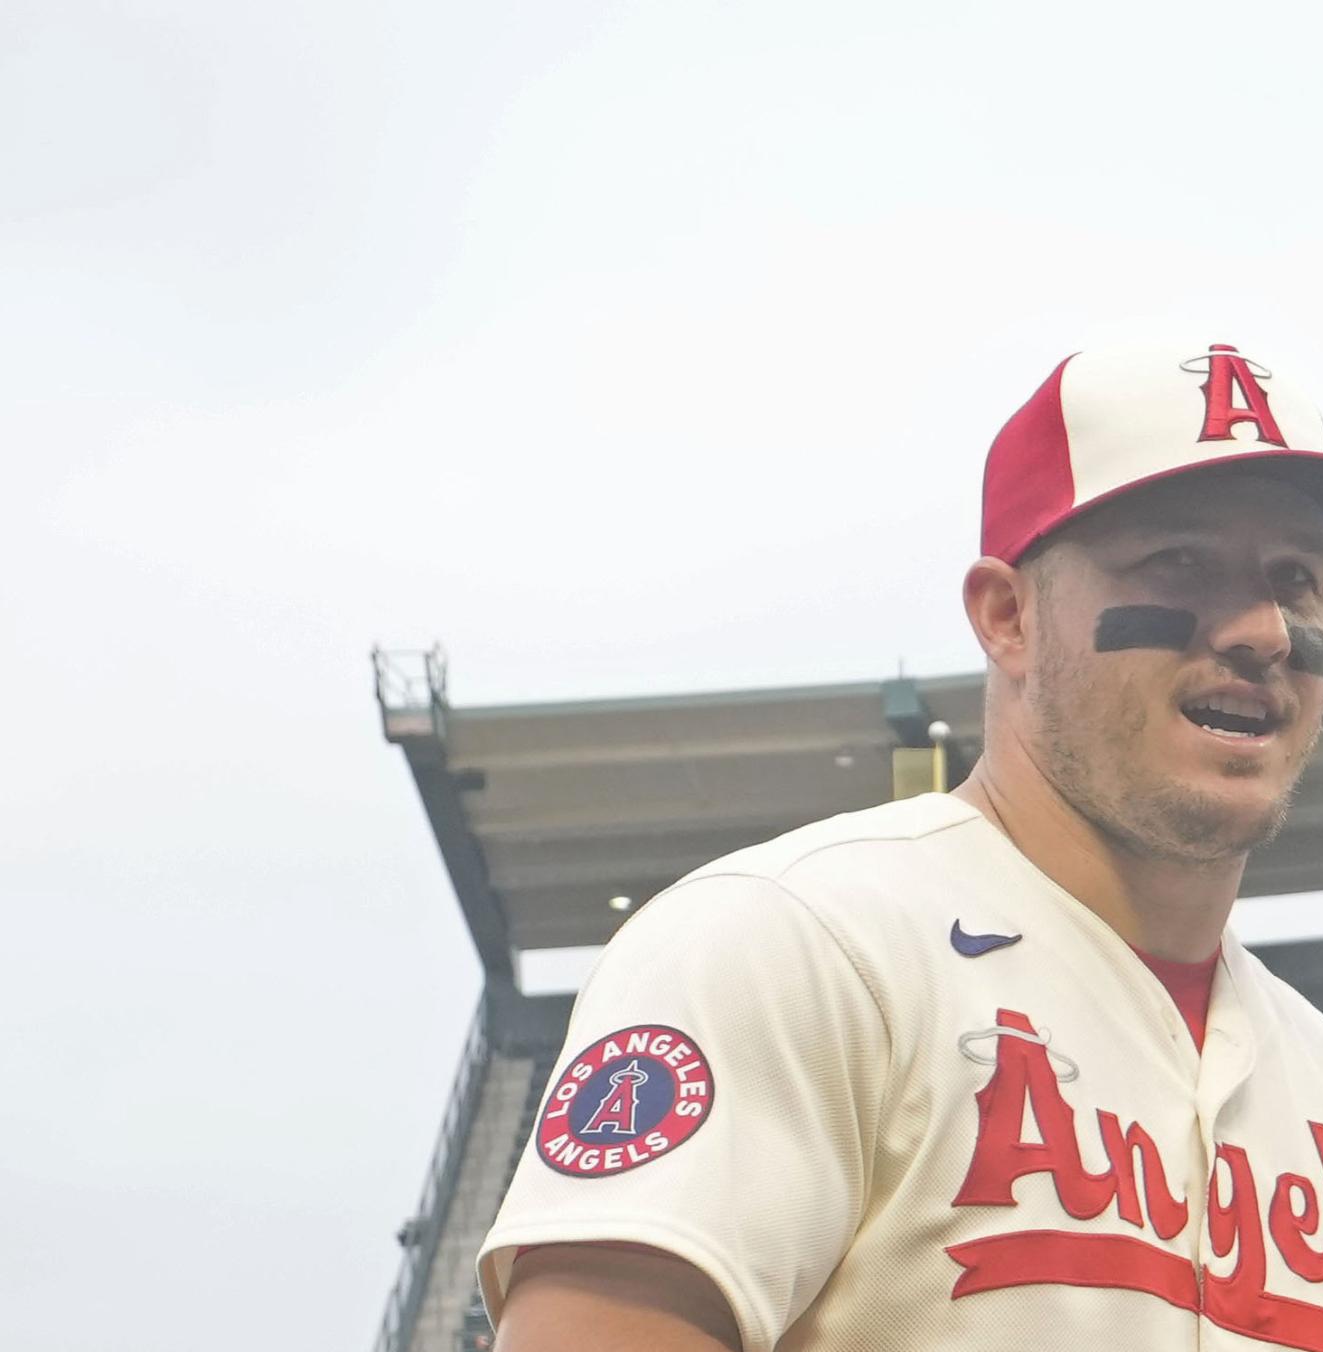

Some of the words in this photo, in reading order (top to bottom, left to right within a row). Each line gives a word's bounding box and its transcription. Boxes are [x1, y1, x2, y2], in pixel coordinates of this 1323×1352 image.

[1197, 344, 1289, 448] A
[547, 1062, 593, 1119] LOS
[602, 1032, 706, 1117] ANGELES
[580, 1060, 648, 1134] A
[544, 1131, 668, 1170] ANGELS
